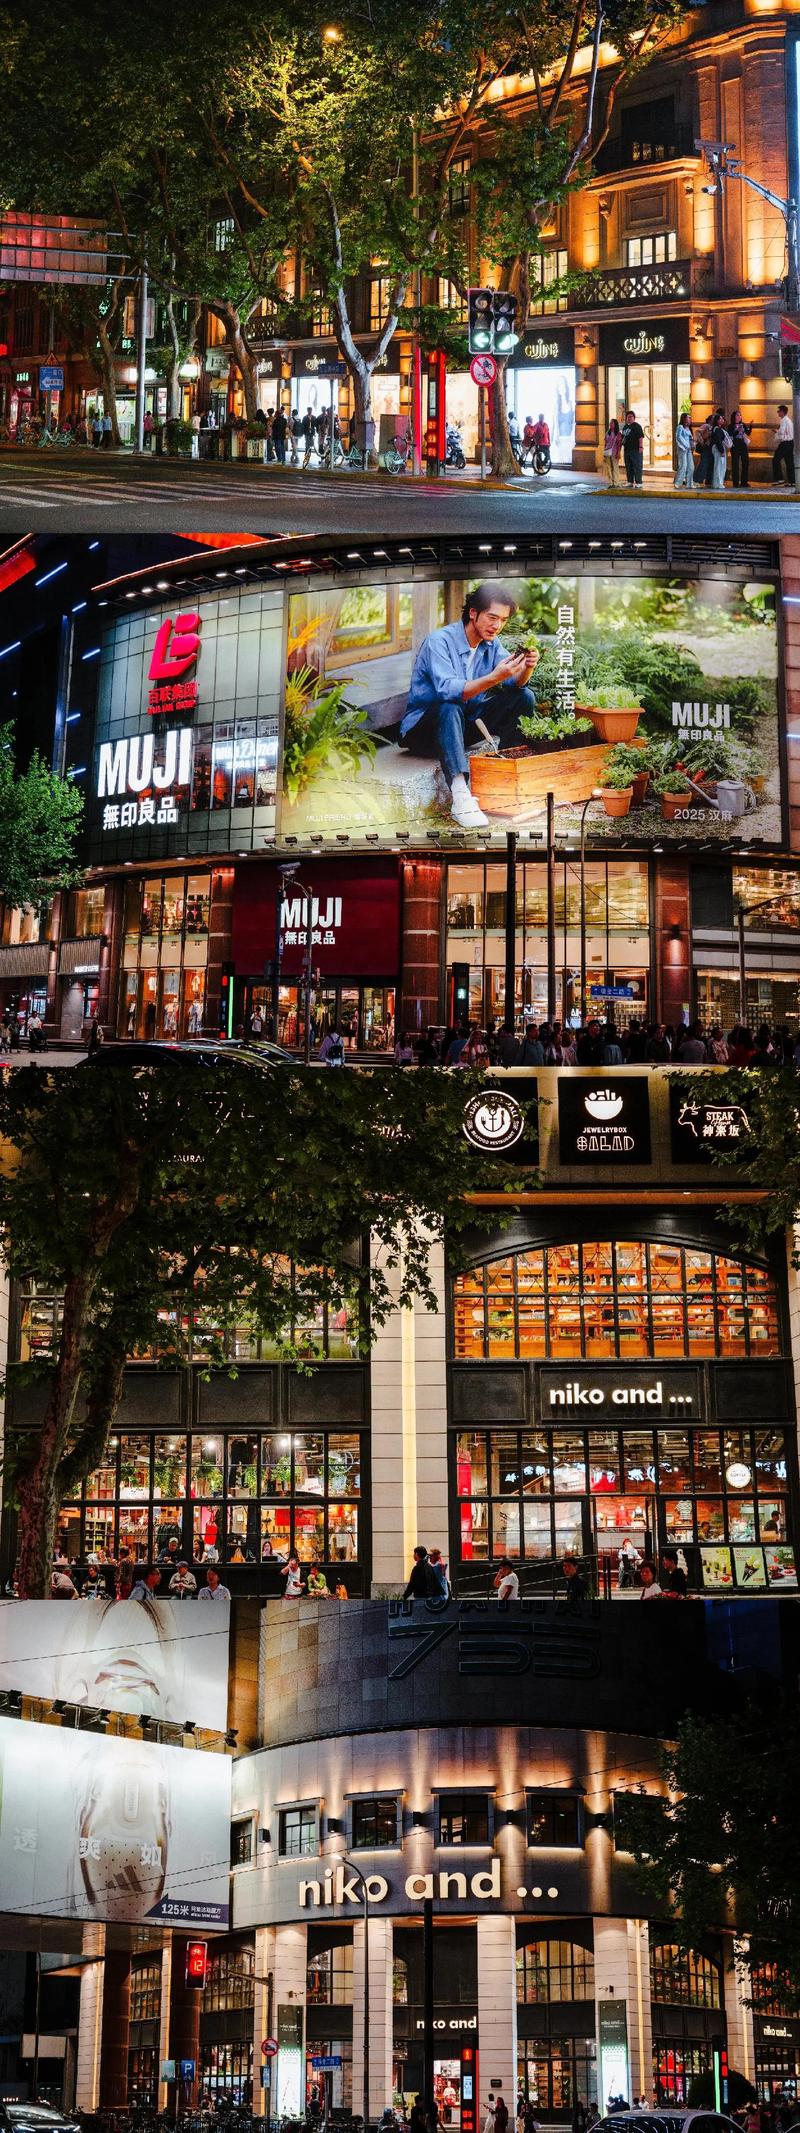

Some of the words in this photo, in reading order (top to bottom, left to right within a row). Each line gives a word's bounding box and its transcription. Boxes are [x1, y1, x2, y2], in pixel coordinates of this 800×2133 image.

[555, 605, 576, 720] 自然有生活。
[671, 702, 731, 728] MUJI
[678, 728, 725, 741] 無印良品
[97, 728, 192, 798] MUJI
[103, 797, 178, 830] 無印良品
[674, 808, 705, 820] 2025
[280, 897, 342, 928] MUJI
[284, 930, 336, 945] 無印良品
[706, 1111, 734, 1121] STEAK
[582, 1126, 628, 1134] JEWELRYBOX
[577, 1136, 635, 1151] SALAD
[549, 1383, 604, 1404] niko
[612, 1382, 663, 1404] and
[298, 1865, 389, 1907] niko
[405, 1858, 501, 1900] and
[161, 1903, 189, 1916] 125米
[449, 2016, 477, 2029] and
[184, 2063, 192, 2074] P
